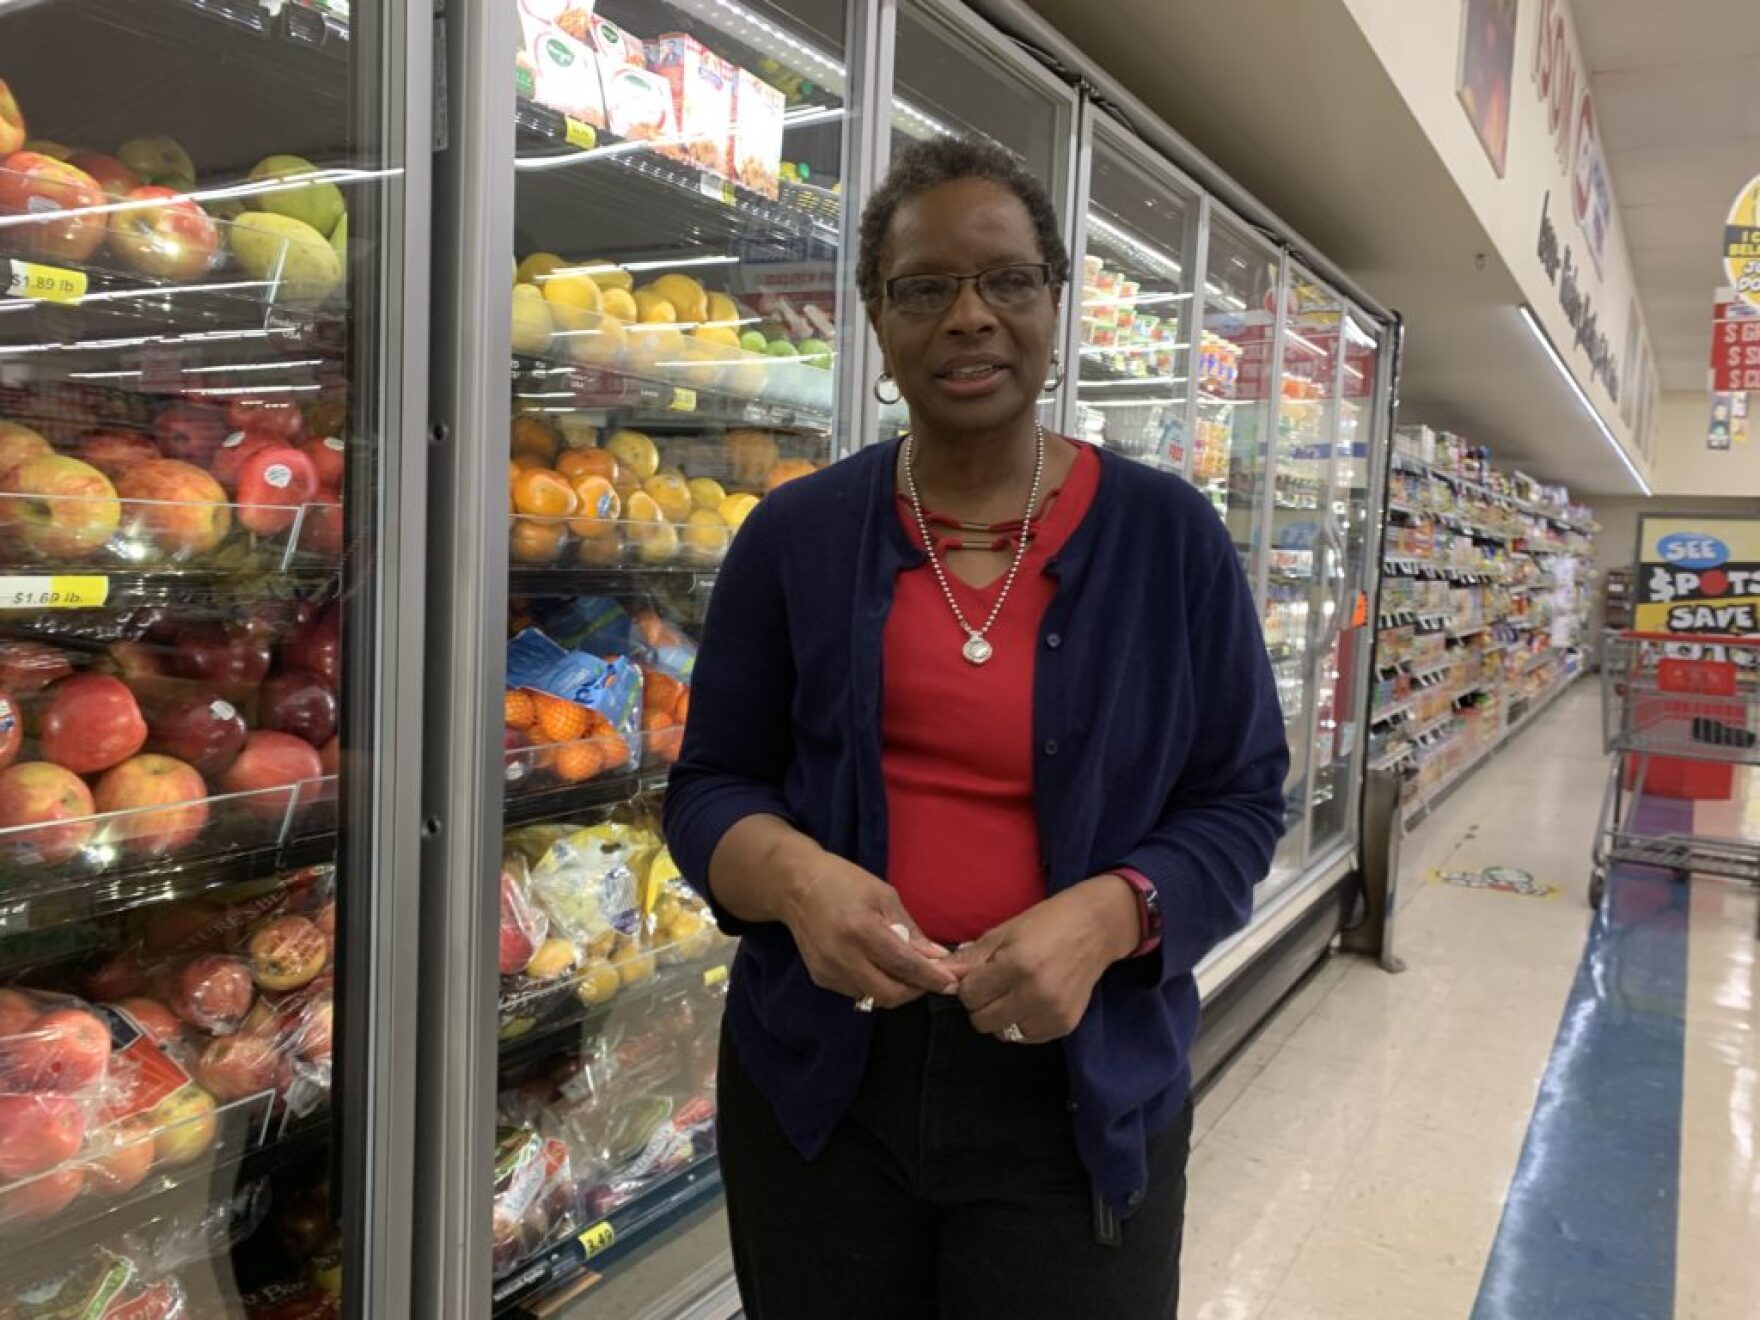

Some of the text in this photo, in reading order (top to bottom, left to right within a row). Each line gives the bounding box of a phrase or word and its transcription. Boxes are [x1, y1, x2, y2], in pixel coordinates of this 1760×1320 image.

[60, 280, 73, 291] lb
[1665, 540, 1717, 561] SEE
[13, 592, 60, 605] $1.69
[1670, 605, 1753, 629] SAVE
